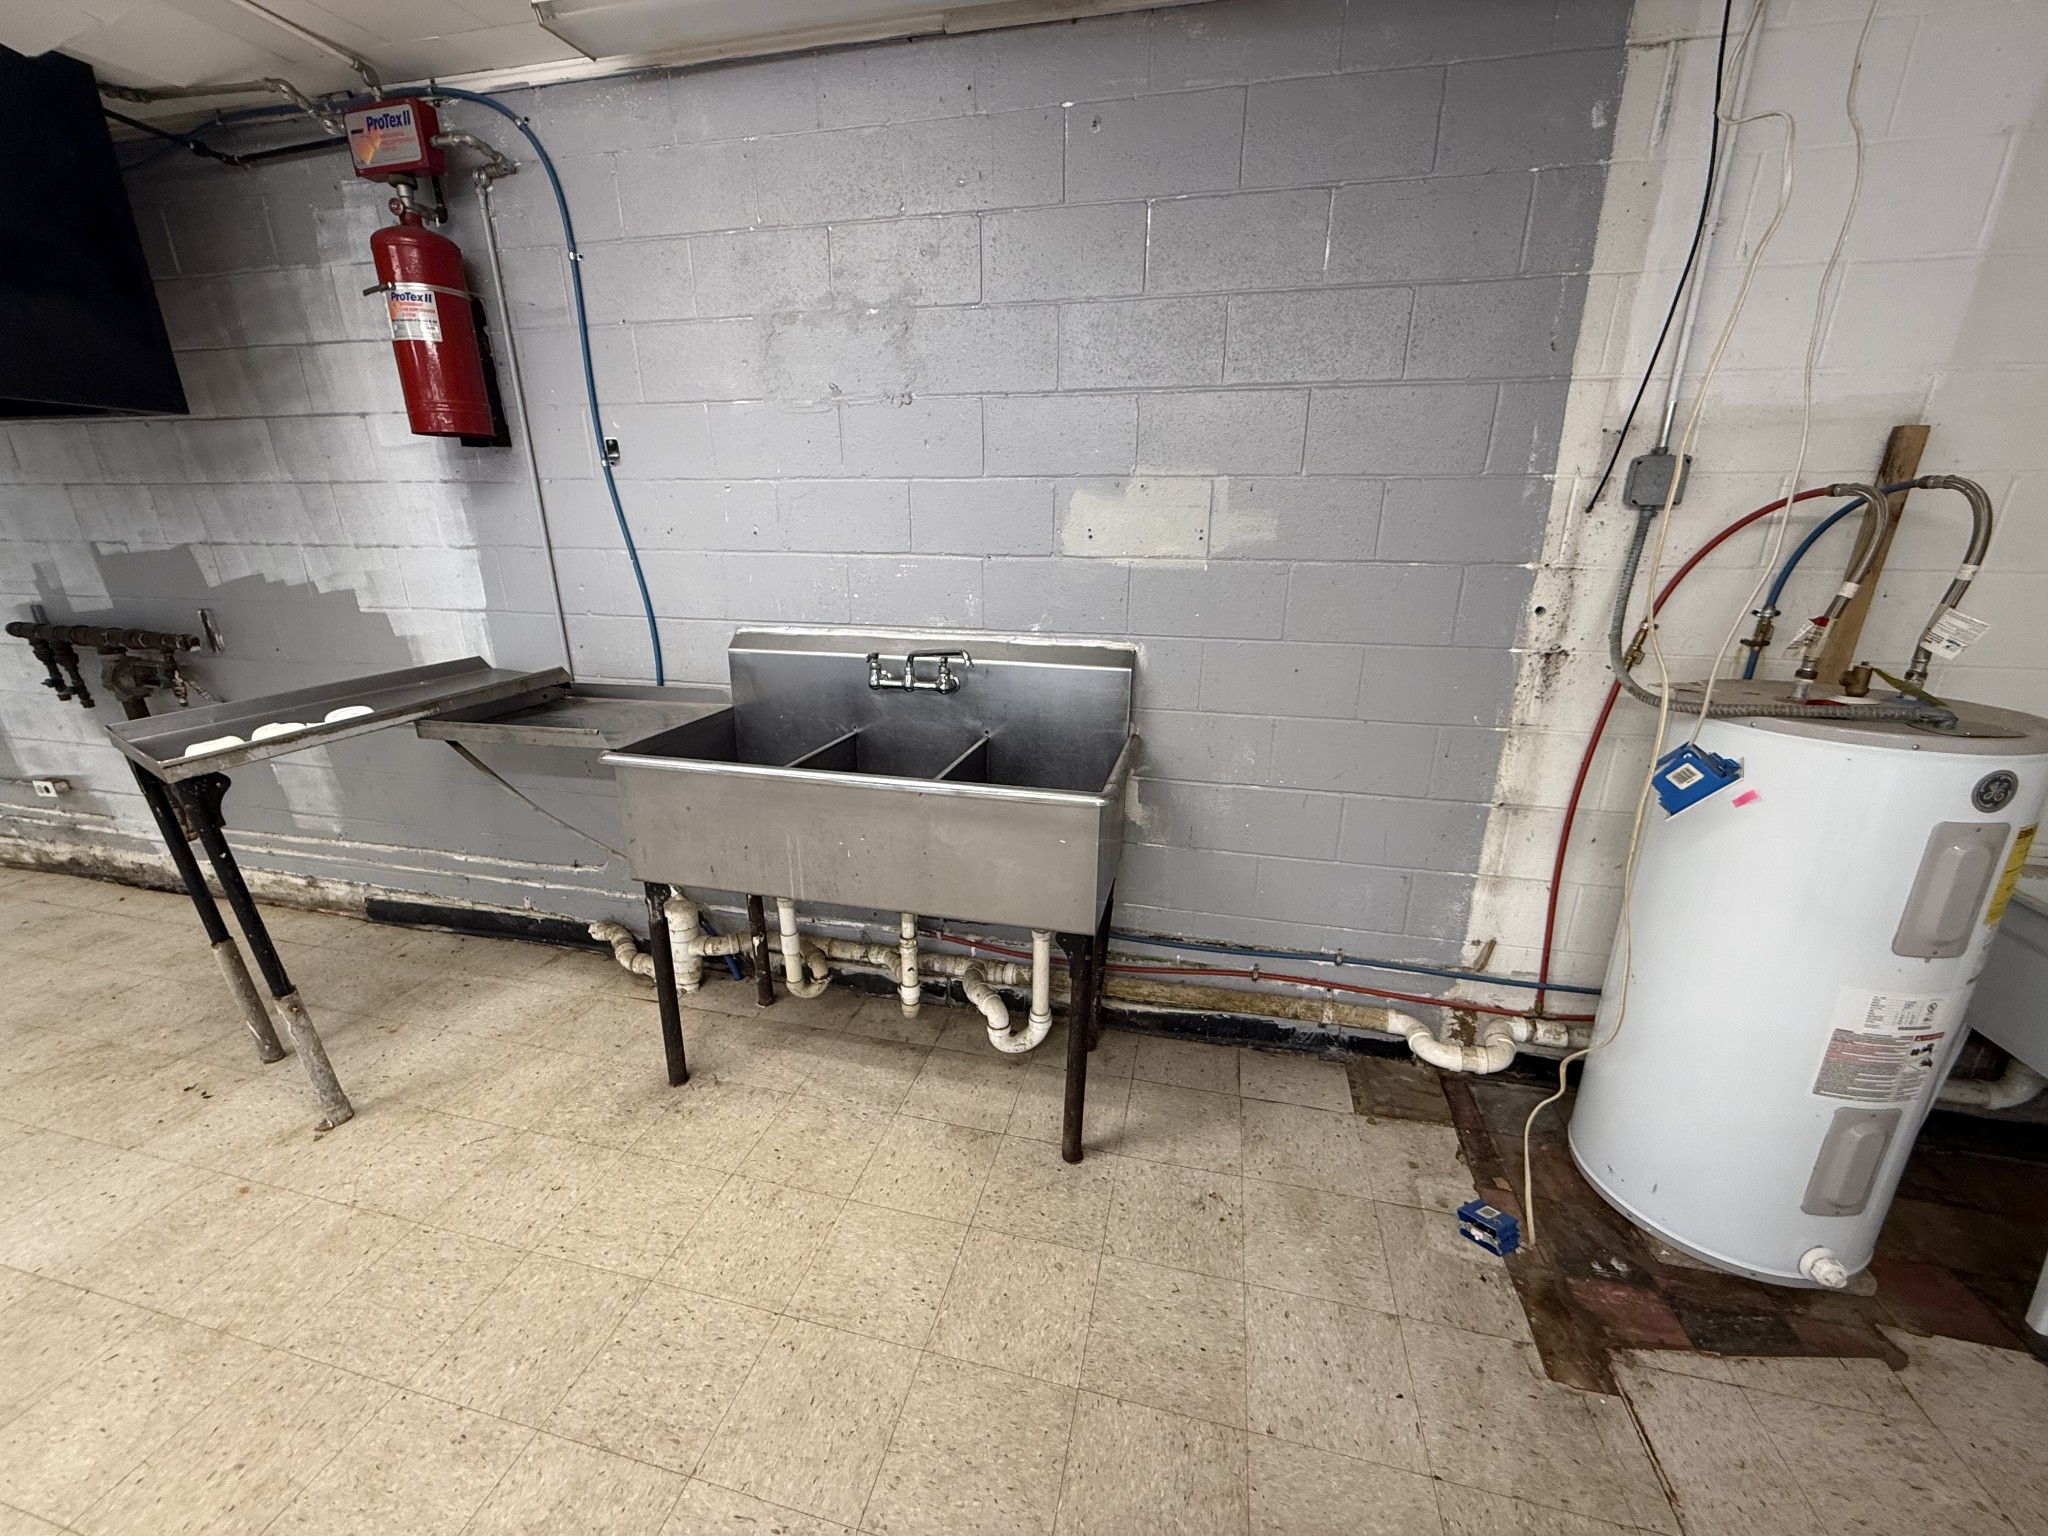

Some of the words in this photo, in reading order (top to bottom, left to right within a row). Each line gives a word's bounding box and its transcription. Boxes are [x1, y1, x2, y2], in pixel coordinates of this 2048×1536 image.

[366, 113, 402, 132] ProTex
[402, 110, 412, 126] II
[390, 292, 424, 302] ProTex
[424, 293, 432, 303] II
